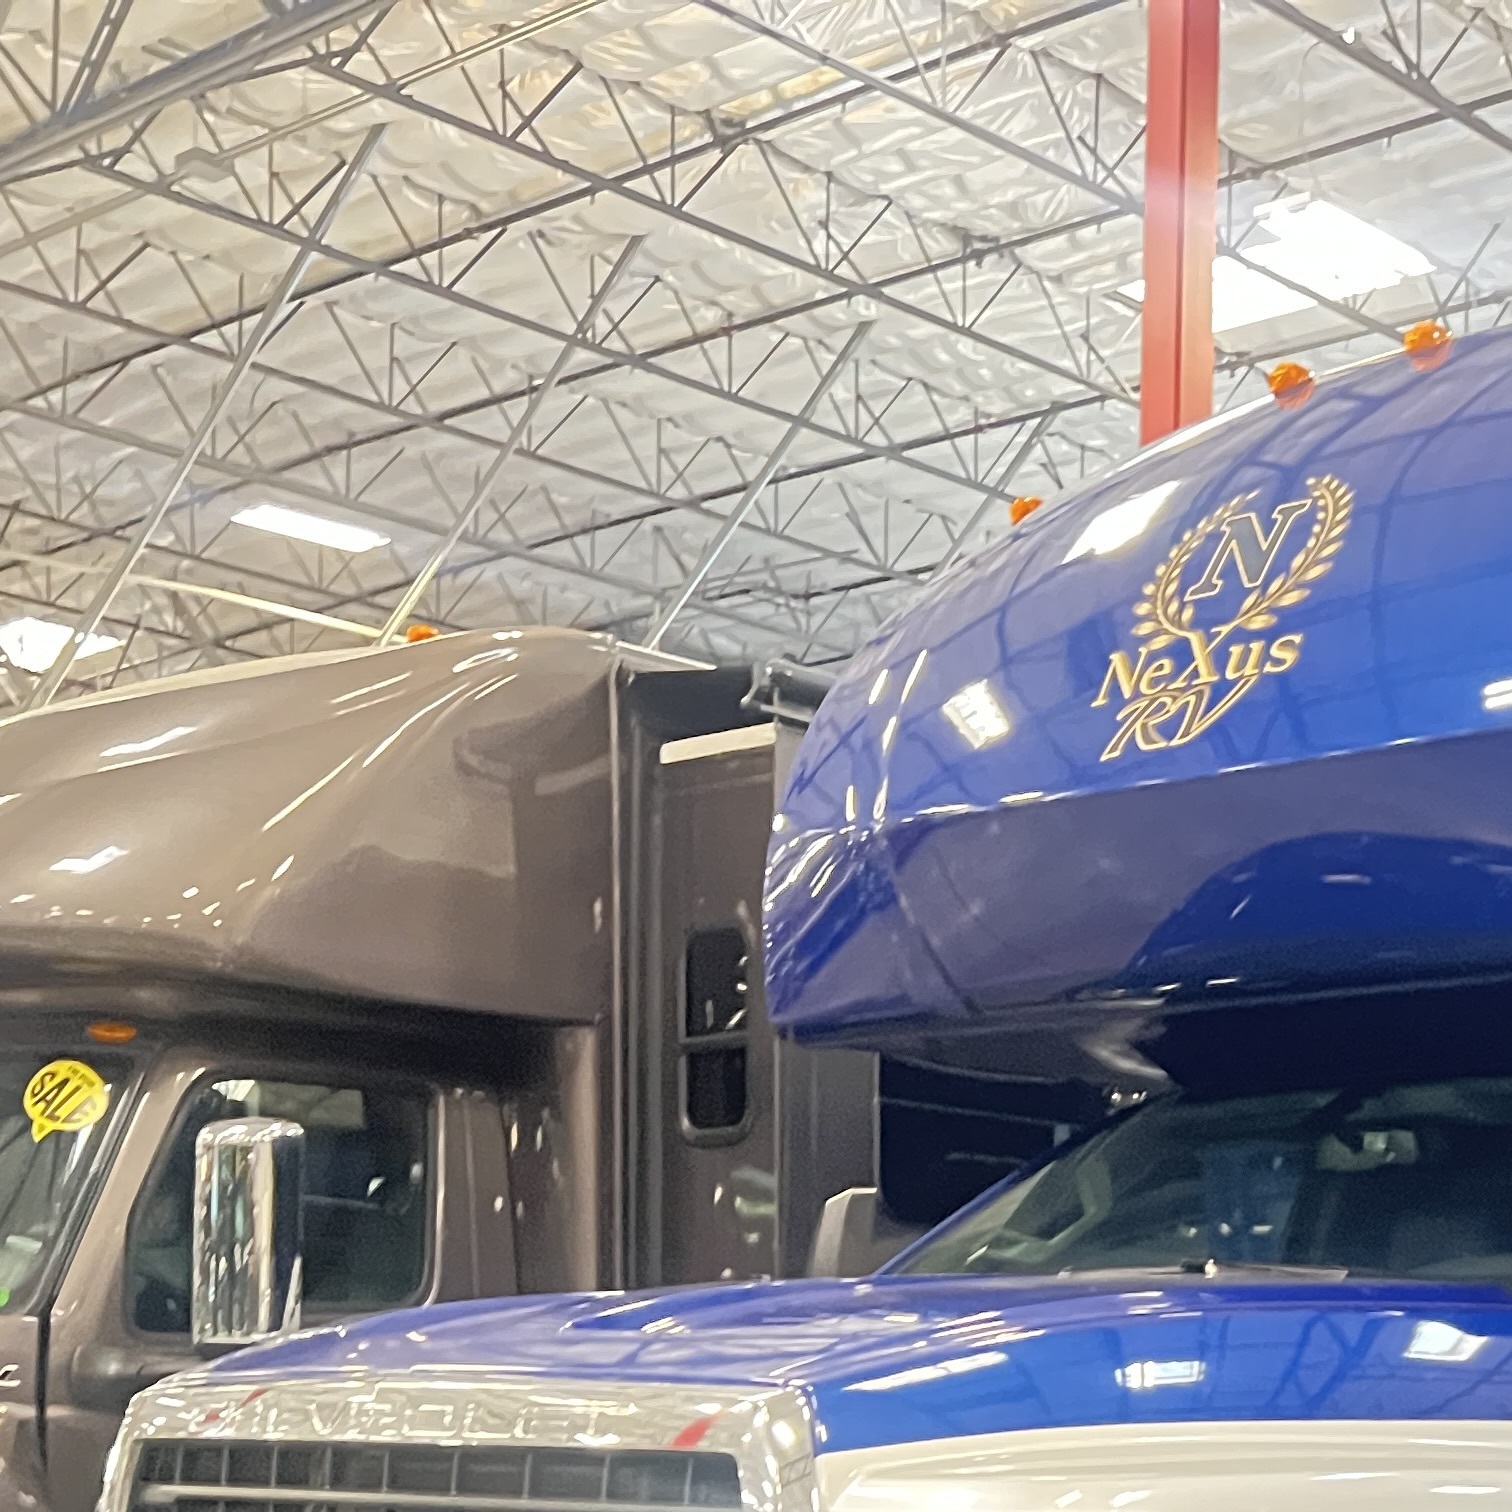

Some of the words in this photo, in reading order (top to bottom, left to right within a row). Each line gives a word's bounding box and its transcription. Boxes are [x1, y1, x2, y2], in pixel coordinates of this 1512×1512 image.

[1184, 498, 1313, 601] N
[1100, 677, 1257, 762] RV
[30, 1071, 98, 1124] SALE
[184, 1399, 637, 1445] CHEVROLET
